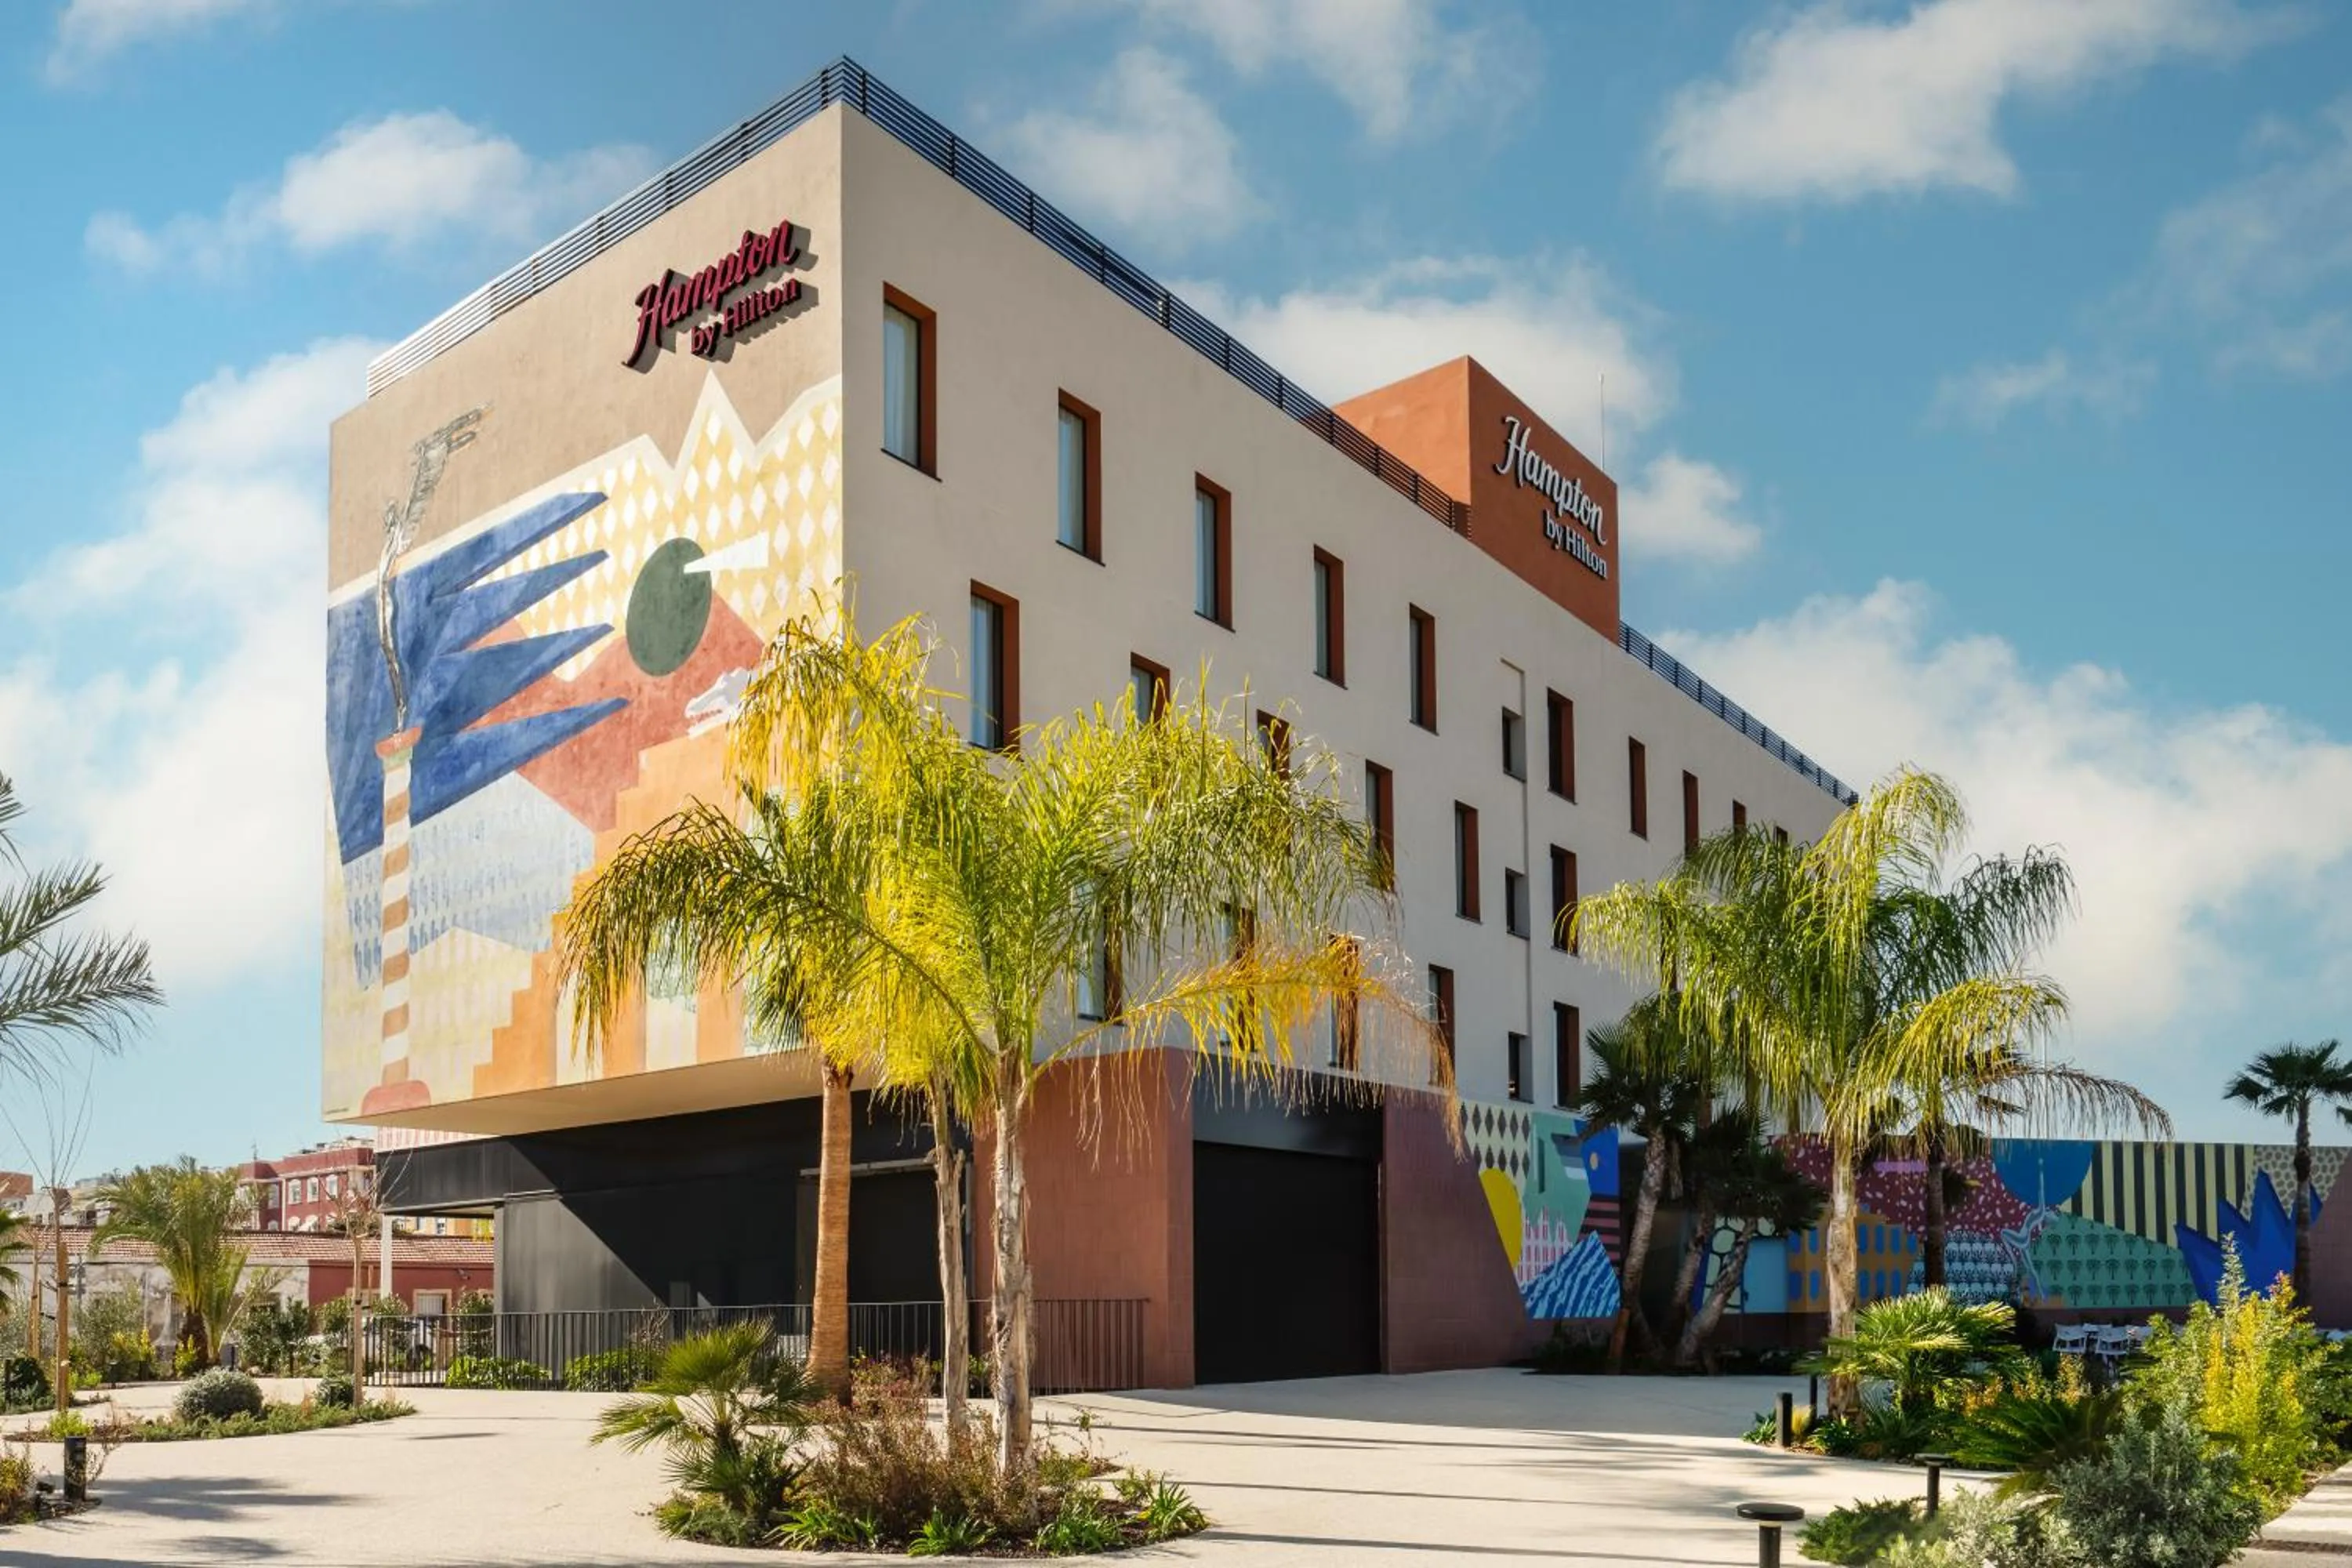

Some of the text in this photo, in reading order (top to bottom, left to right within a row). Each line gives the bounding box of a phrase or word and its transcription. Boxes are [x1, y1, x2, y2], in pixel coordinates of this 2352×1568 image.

[621, 219, 801, 367] Hampton
[690, 278, 802, 358] by Hilton
[1494, 416, 1607, 546] Hampton
[1545, 510, 1607, 579] by Hilton
